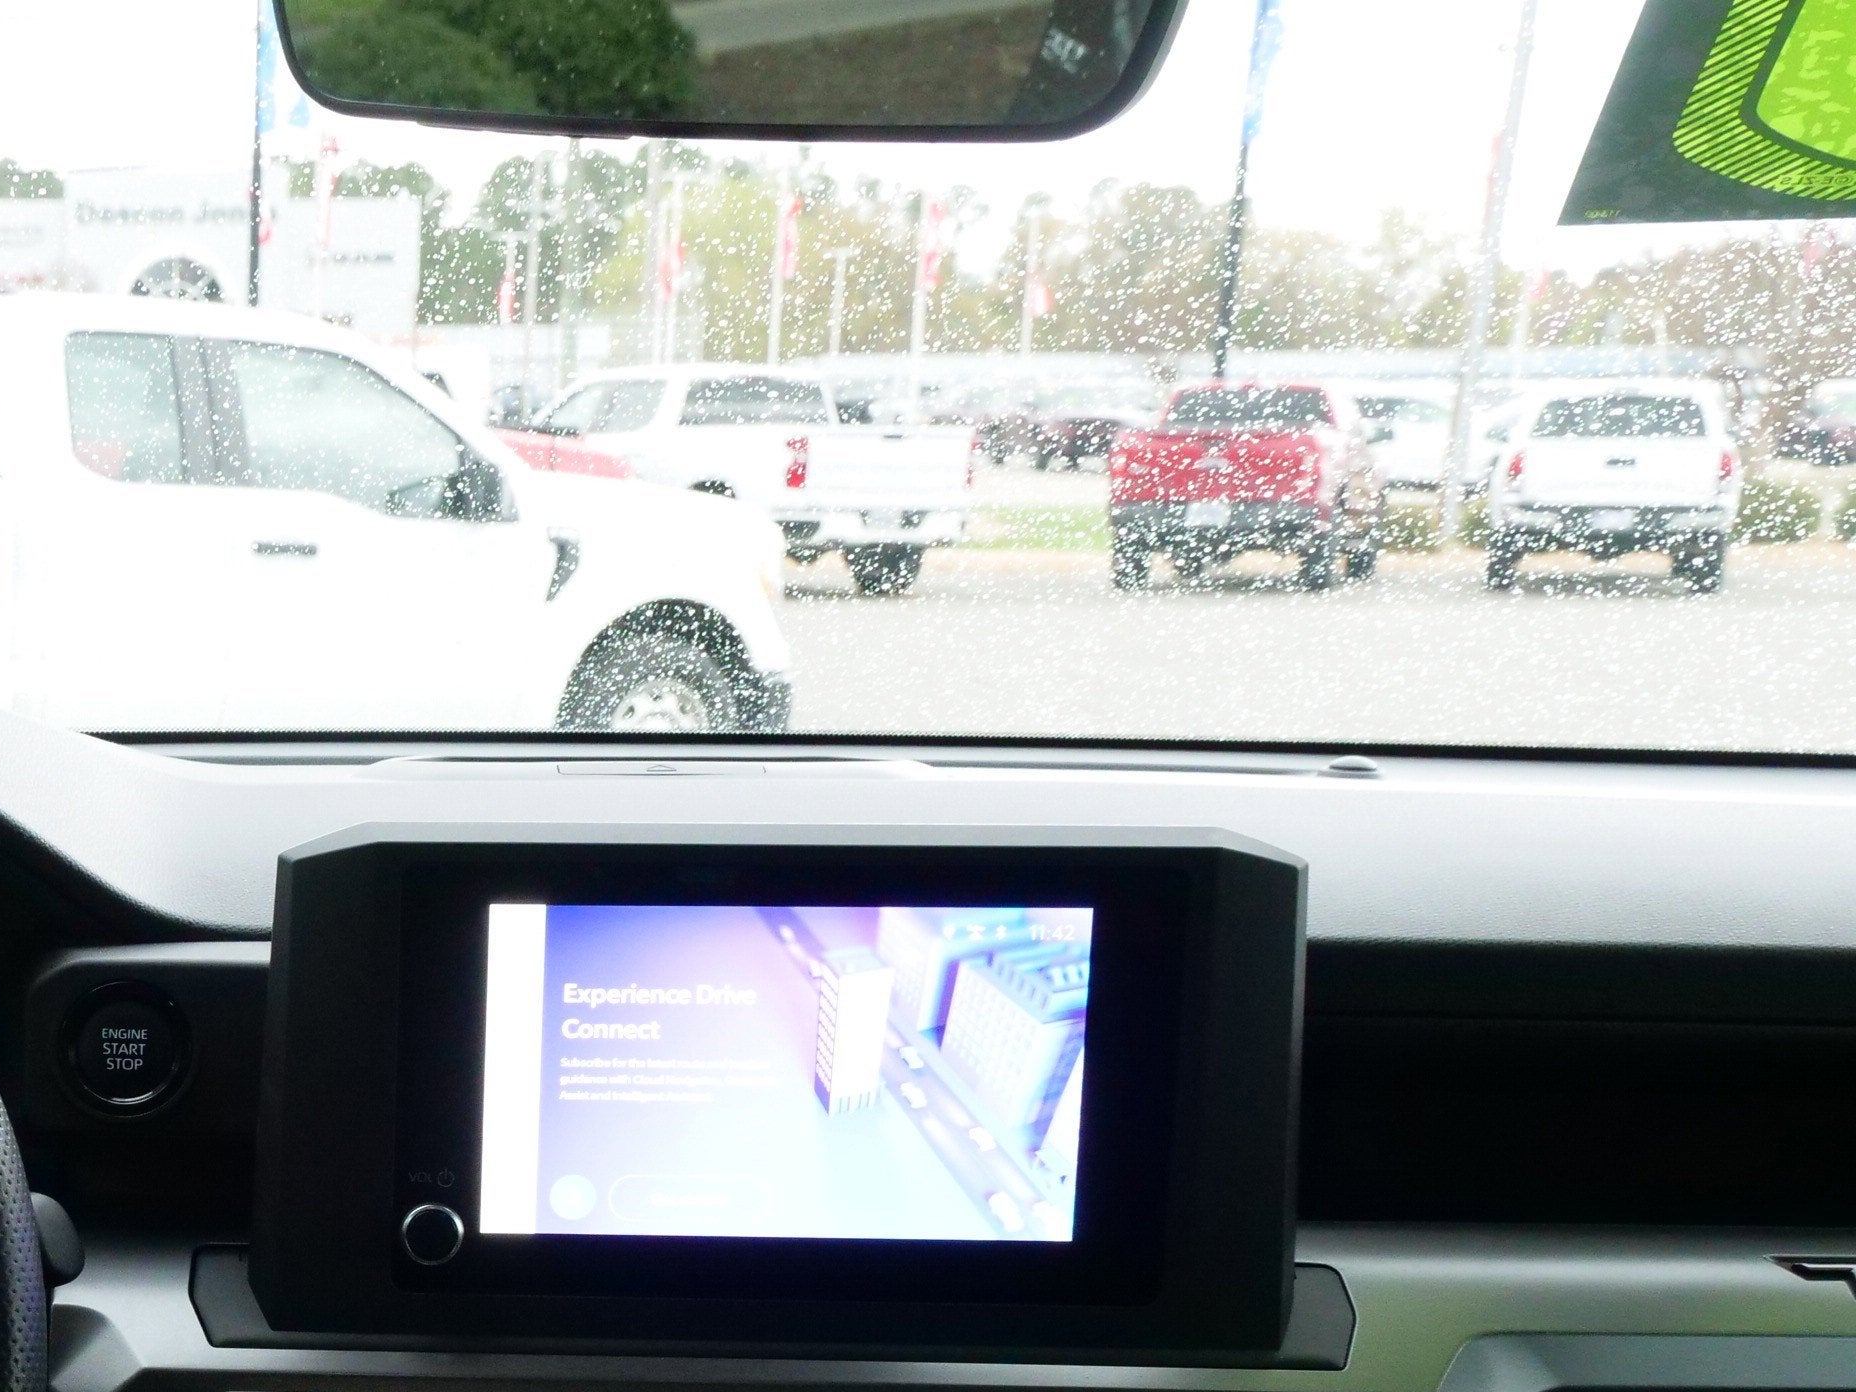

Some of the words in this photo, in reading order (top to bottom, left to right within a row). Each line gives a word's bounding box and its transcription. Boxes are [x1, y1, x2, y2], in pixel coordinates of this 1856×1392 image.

[1030, 924, 1076, 940] 11:42
[563, 983, 692, 1008] Experience
[696, 984, 758, 1005] Drive
[102, 1028, 148, 1040] ENGINE
[561, 1019, 662, 1040] Connect
[102, 1042, 146, 1055] START
[106, 1058, 144, 1070] STOP
